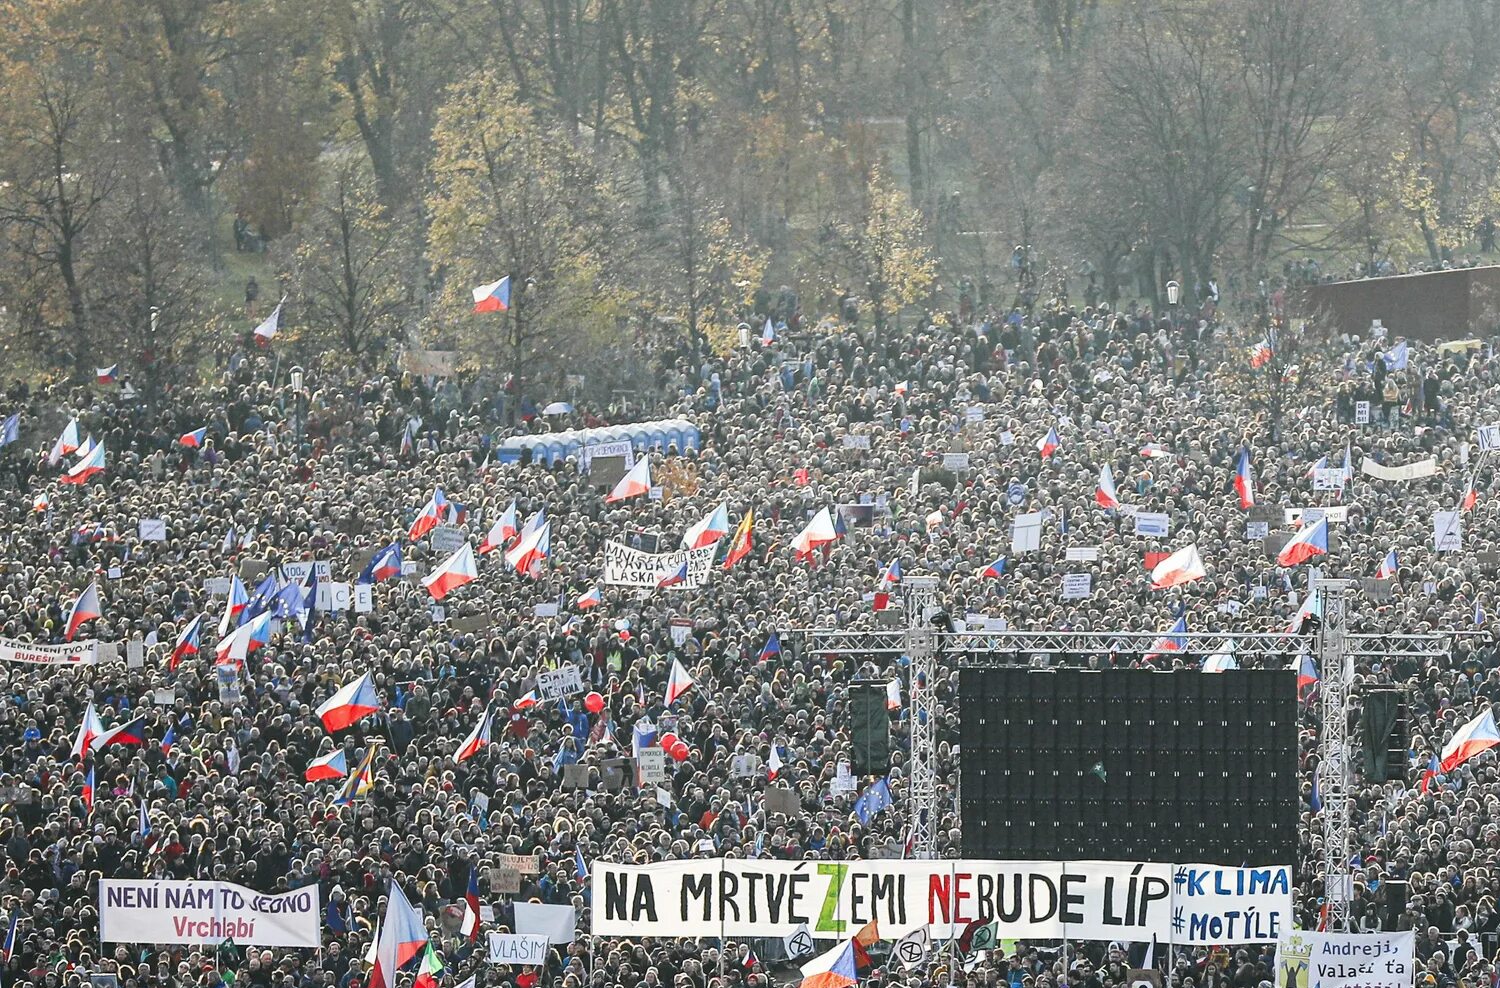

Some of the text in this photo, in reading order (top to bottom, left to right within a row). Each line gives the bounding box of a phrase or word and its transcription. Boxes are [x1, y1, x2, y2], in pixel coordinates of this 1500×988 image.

[62, 643, 95, 655] TVOJE
[1173, 866, 1289, 895] #KLIMA
[106, 885, 311, 916] NENÍ NÁM TO JEDNO
[605, 861, 1170, 932] NA MRTVÉ ZEMI NEBUDE LÍP
[172, 915, 255, 939] Vrchlabí
[491, 937, 546, 960] VLAŠIM
[1322, 941, 1399, 958] Andreji,
